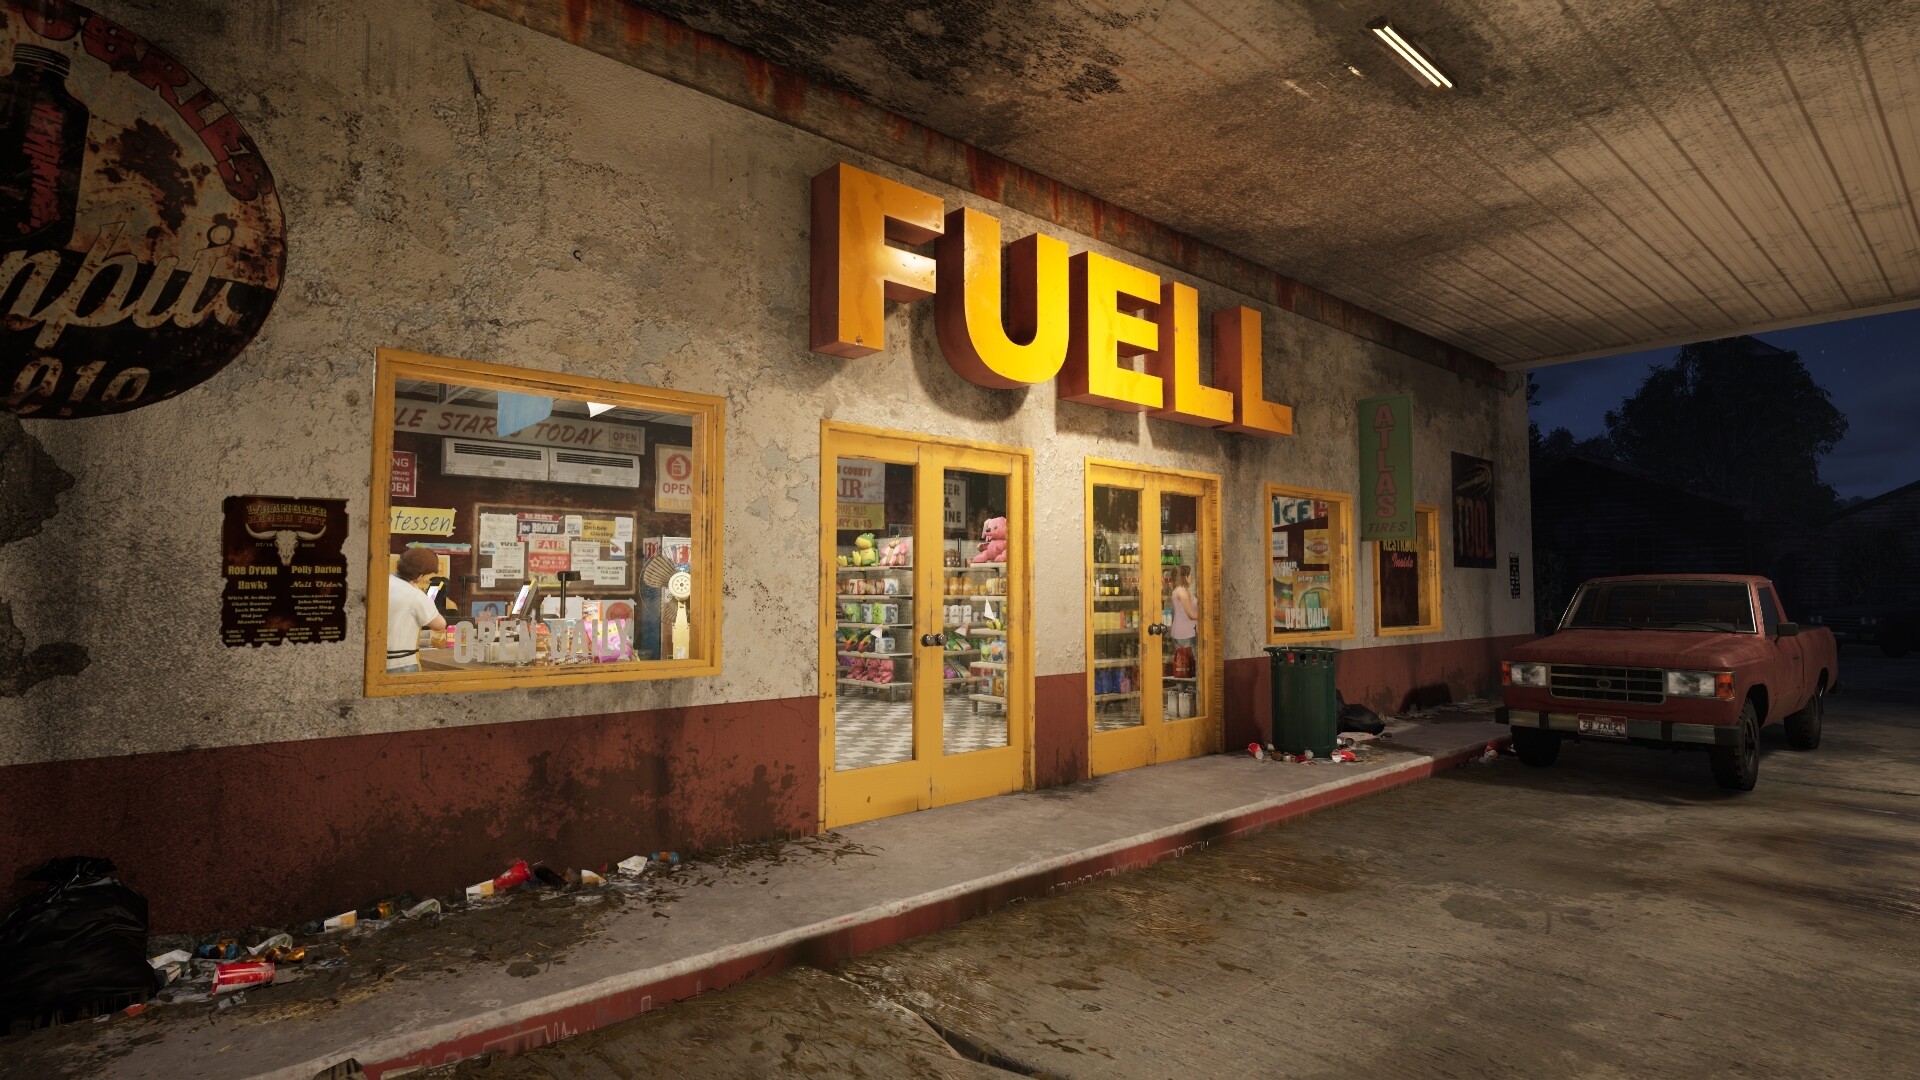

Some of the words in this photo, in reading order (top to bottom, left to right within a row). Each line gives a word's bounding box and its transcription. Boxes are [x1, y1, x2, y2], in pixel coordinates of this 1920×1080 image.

[811, 162, 1292, 438] FUELL
[437, 412, 521, 437] STAR
[534, 423, 602, 446] TODAY
[613, 431, 637, 443] OPEN
[1373, 403, 1397, 518] ATLAS
[843, 466, 872, 478] COUNTY
[391, 511, 451, 531] tessen
[519, 523, 531, 534] Joe
[532, 523, 559, 534] BROWN
[1367, 520, 1408, 534] TIRES
[536, 540, 564, 549] FAIR
[453, 620, 537, 664] OPEN
[550, 618, 633, 661] DAILY
